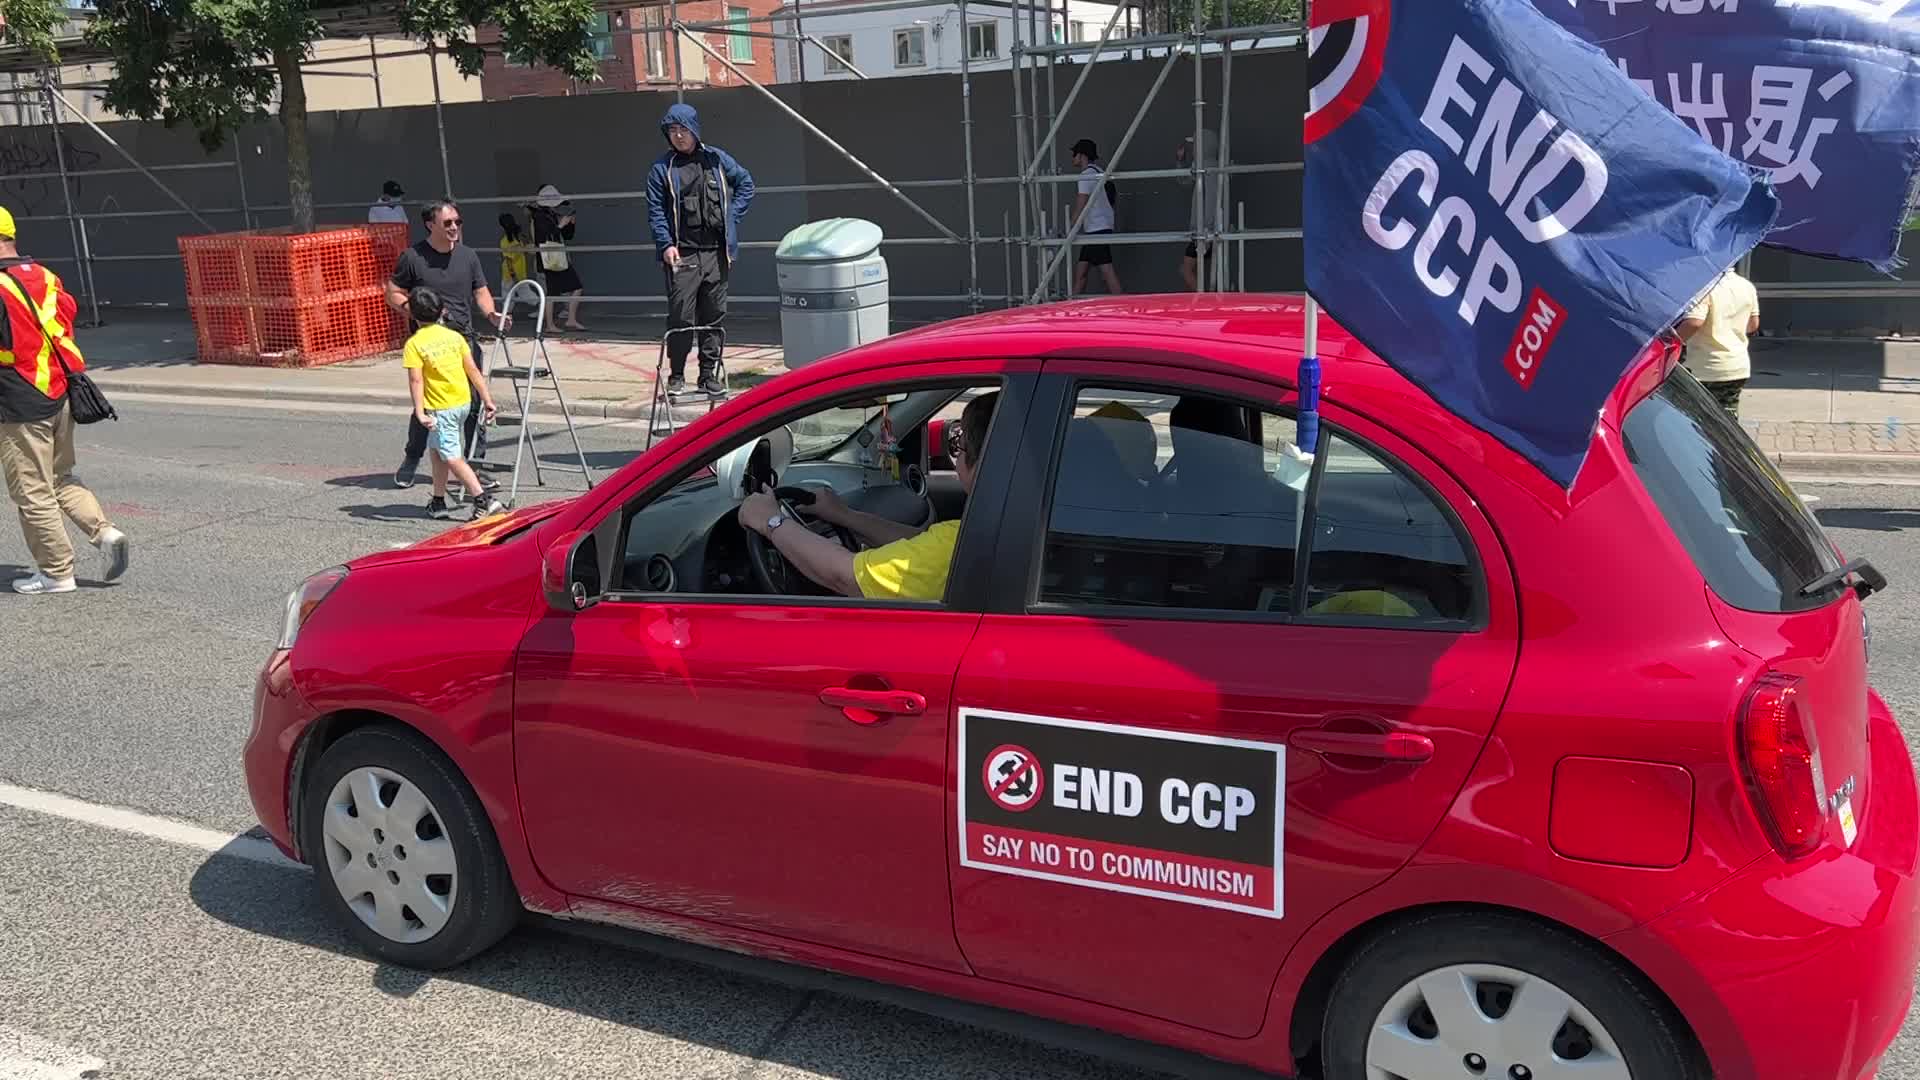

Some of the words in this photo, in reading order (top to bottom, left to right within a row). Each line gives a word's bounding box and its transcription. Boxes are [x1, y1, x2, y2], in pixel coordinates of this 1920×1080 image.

[1420, 35, 1608, 243] END
[1361, 149, 1523, 327] CCP
[1515, 301, 1557, 380] .COM
[1053, 763, 1143, 817] END
[1160, 778, 1256, 832] CCP
[983, 834, 1024, 860] SAY
[1030, 840, 1061, 867] NO
[1065, 846, 1095, 872] TO
[1102, 852, 1254, 897] COMMUNISM
